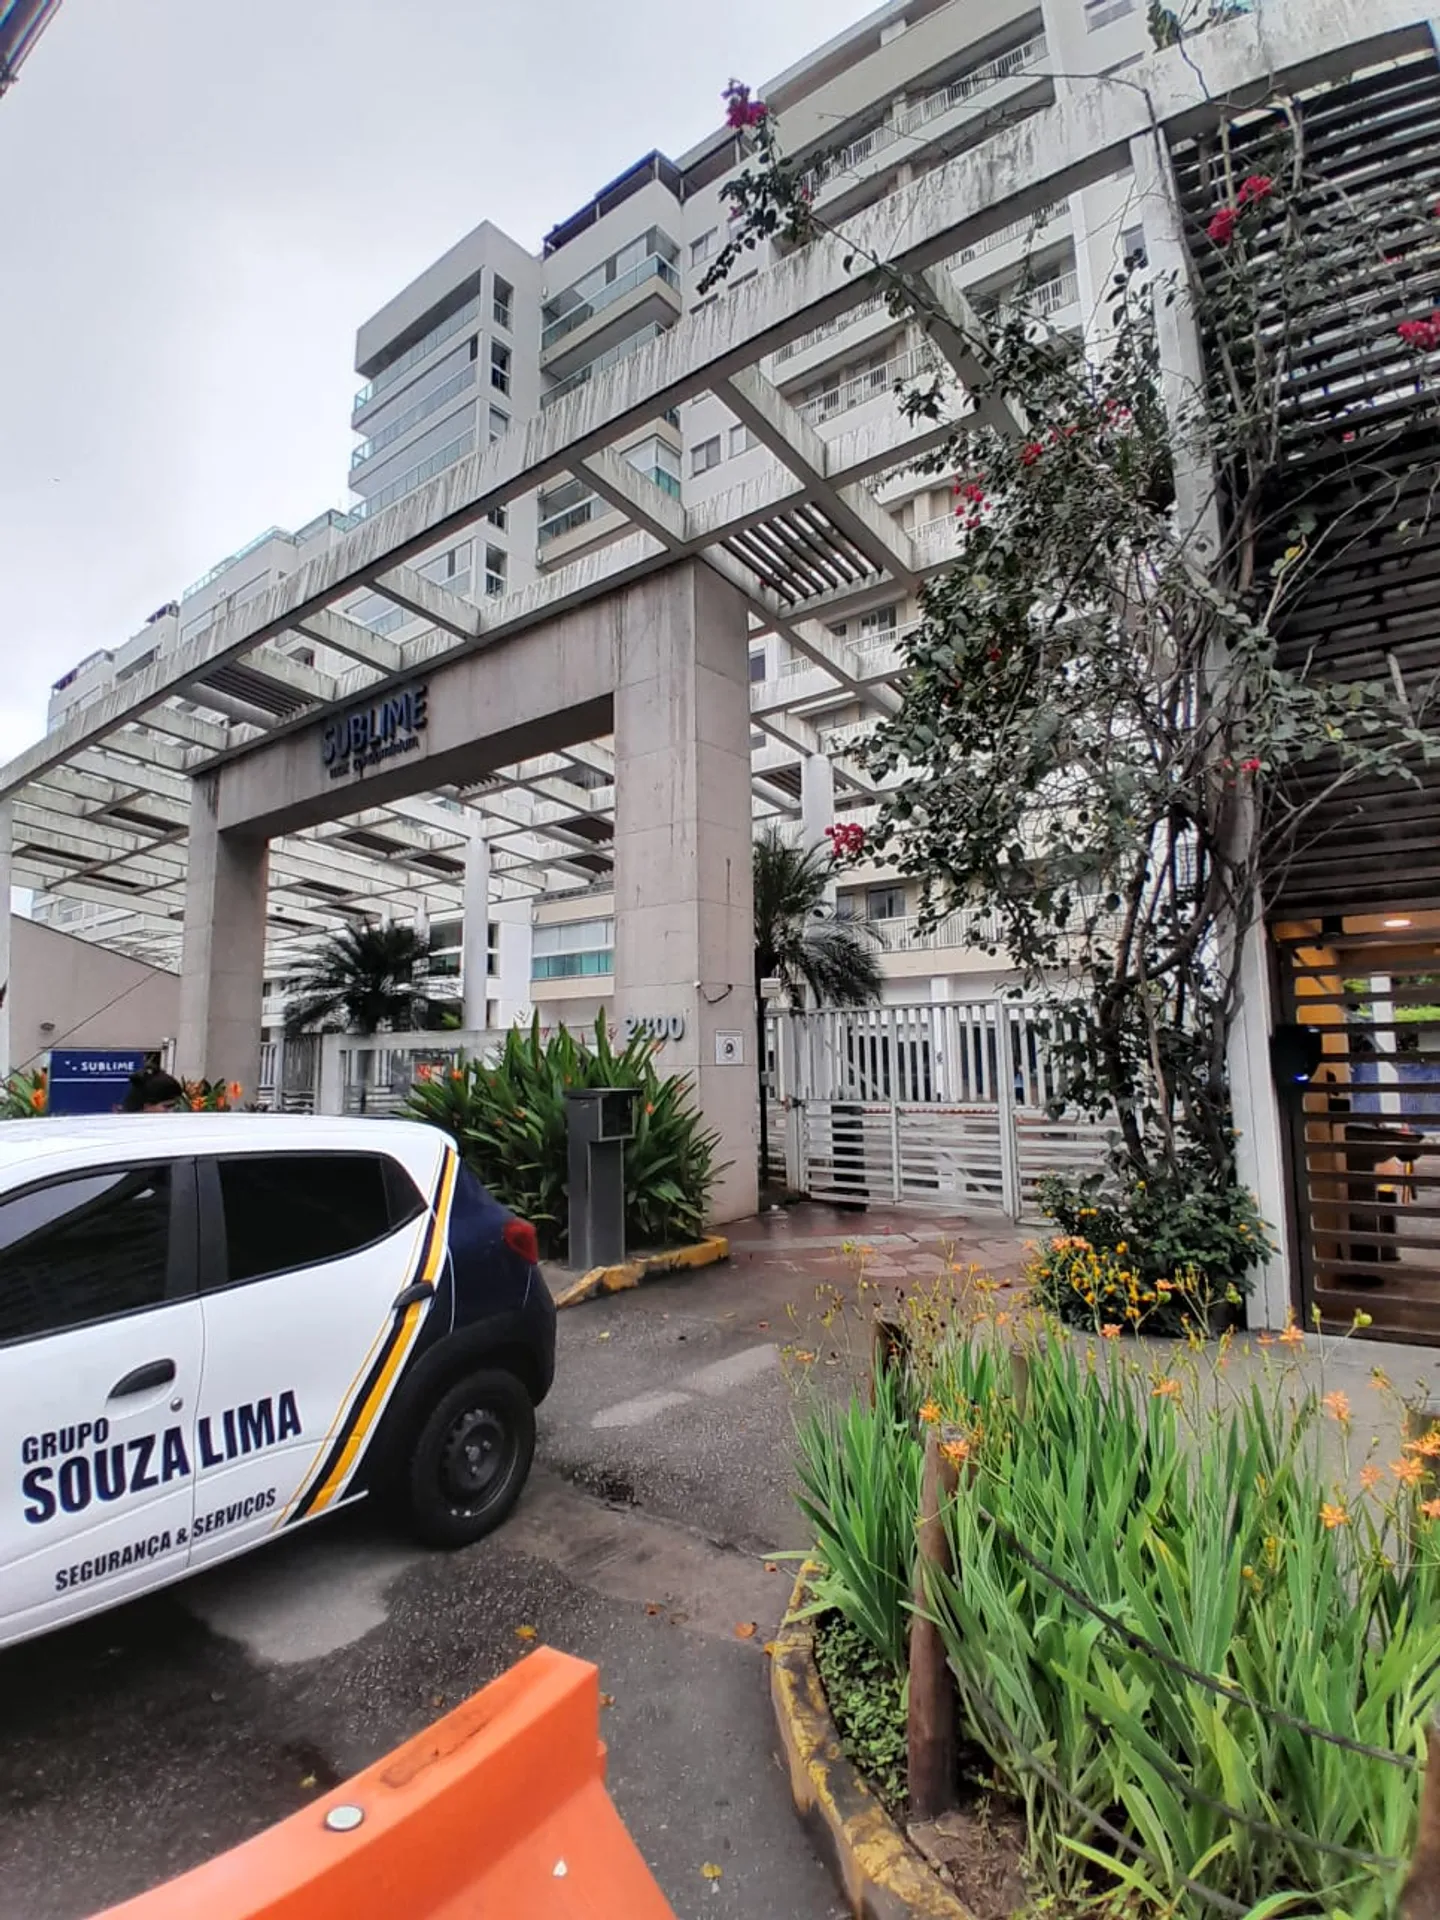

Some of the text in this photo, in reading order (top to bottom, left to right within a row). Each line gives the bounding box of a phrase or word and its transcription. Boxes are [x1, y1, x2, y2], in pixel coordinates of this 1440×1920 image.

[81, 1061, 134, 1071] SUBLIME
[22, 1417, 108, 1464] GRUPO
[22, 1390, 302, 1524] SOUZA LIMA
[55, 1488, 276, 1591] SEGURANÇA & SERVIÇOS
